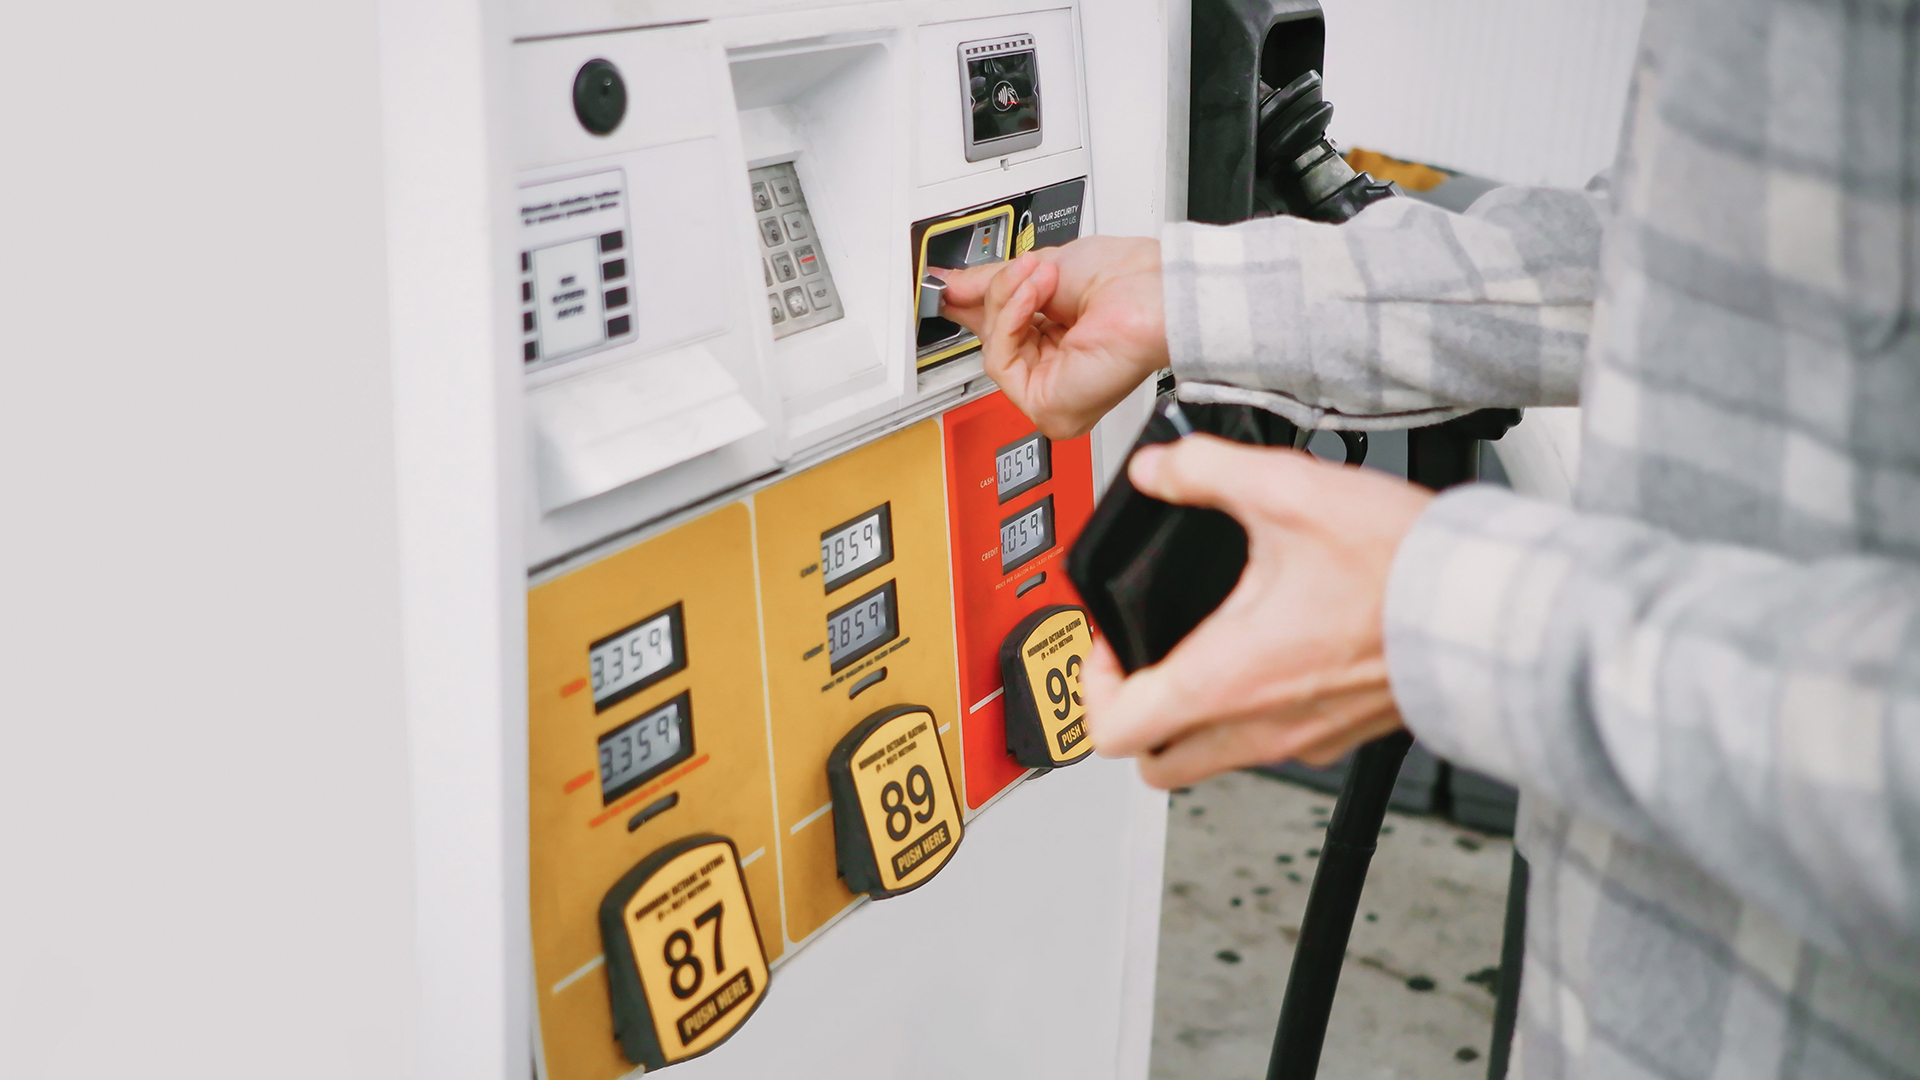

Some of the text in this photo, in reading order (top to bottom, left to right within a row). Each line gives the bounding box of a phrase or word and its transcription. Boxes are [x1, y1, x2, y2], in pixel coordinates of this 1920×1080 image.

[758, 194, 767, 206] 3
[1039, 205, 1079, 223] YOUR SECURITY
[771, 229, 779, 242] 6
[1037, 220, 1061, 234] MATTERS
[1062, 217, 1069, 227] TO
[783, 265, 791, 277] 9
[980, 476, 995, 489] CASH
[822, 523, 873, 576] 3.859
[981, 546, 999, 562] CREDIT
[827, 601, 879, 655] 3.859
[1027, 617, 1081, 658] MINIMUM OCTANE RATING
[1058, 634, 1074, 648] METHOD
[592, 627, 662, 693] 3.359
[1046, 654, 1085, 722] 93
[600, 715, 670, 785] 3.359
[886, 734, 907, 753] OCTANE
[908, 721, 928, 739] RATING
[1061, 724, 1082, 747] PUSH
[881, 764, 935, 842] 89
[897, 827, 947, 873] PUSH HERE
[663, 899, 725, 1001] 87
[684, 975, 749, 1038] PUSH HERE
